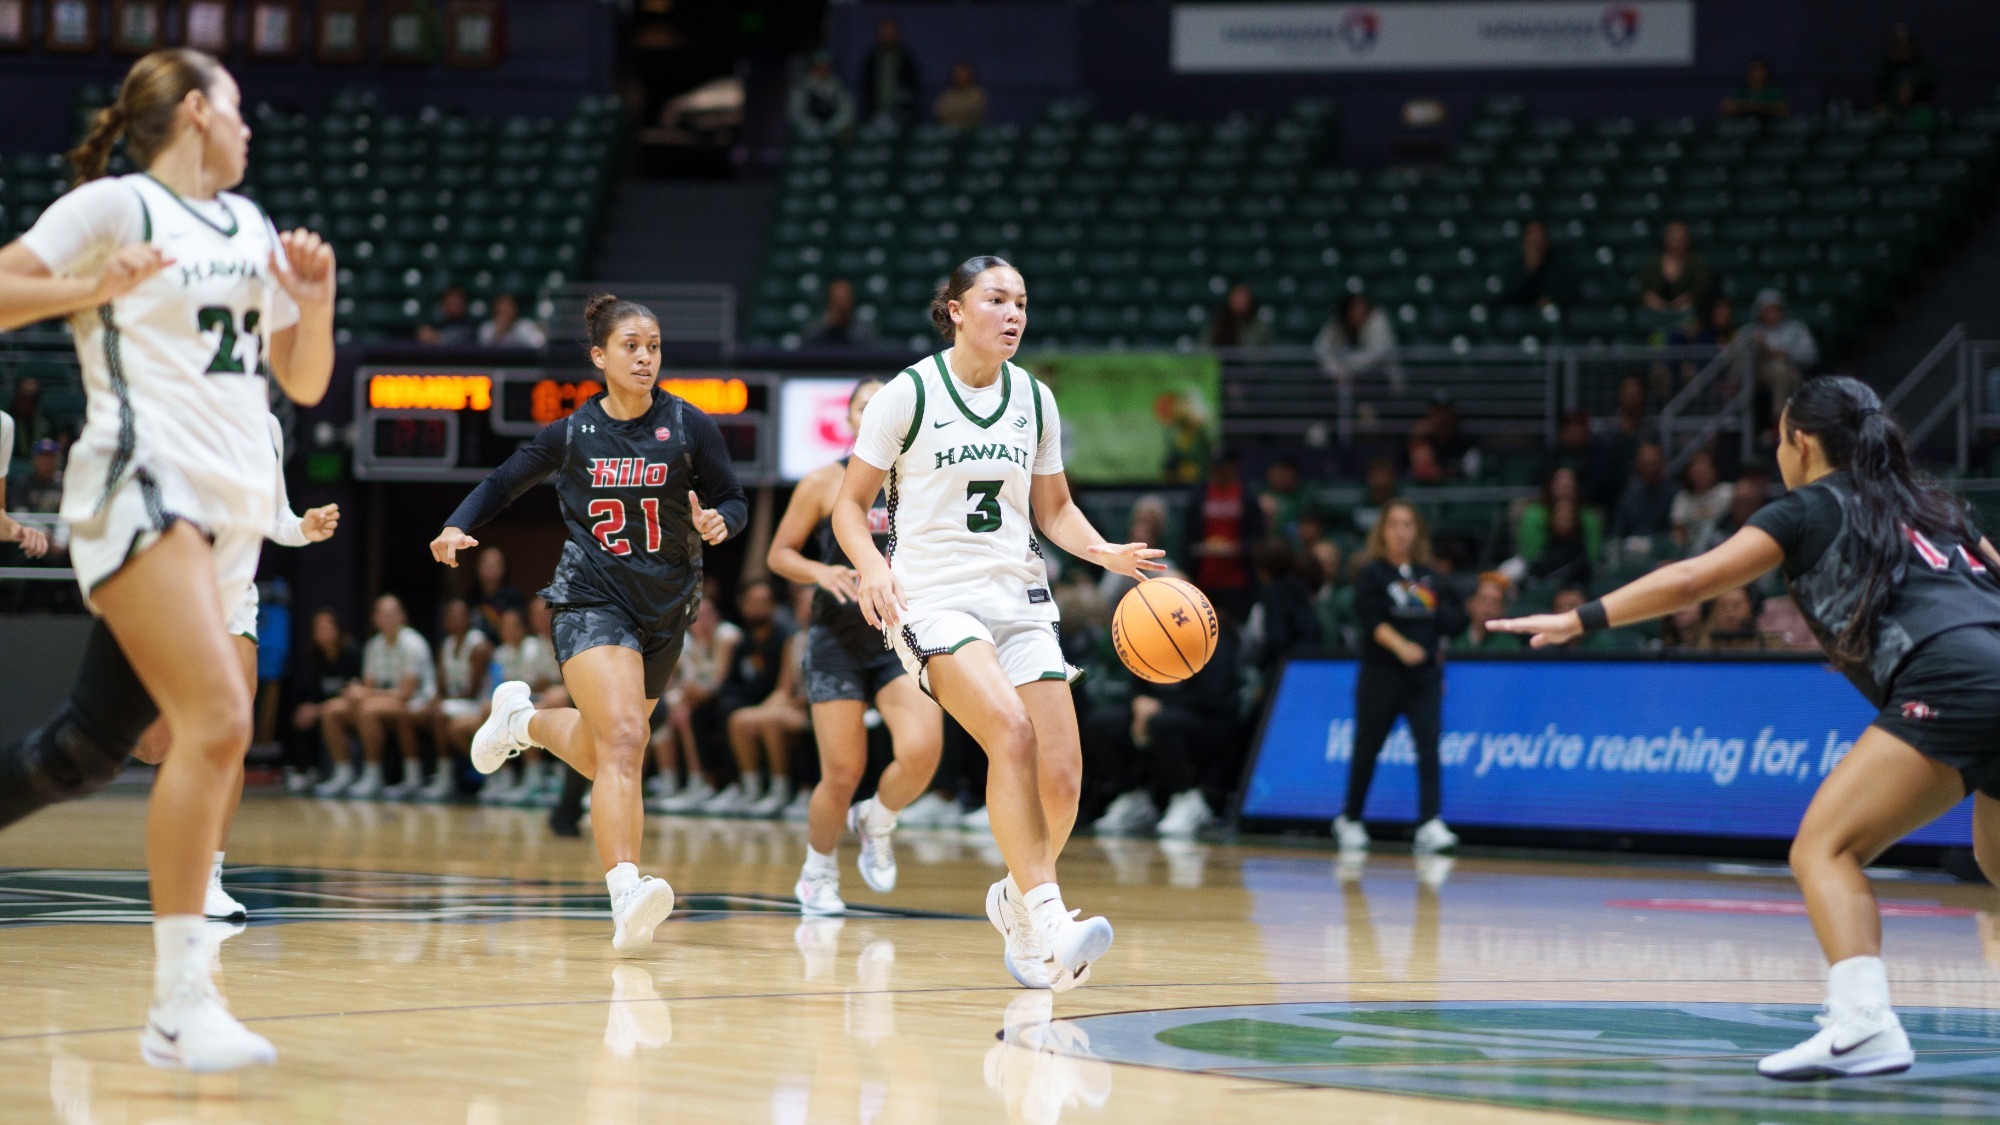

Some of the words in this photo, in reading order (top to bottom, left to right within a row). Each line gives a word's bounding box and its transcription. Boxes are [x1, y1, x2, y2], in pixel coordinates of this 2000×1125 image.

[586, 457, 668, 488] Hilo
[588, 498, 662, 556] 21
[966, 479, 1005, 534] 3
[1474, 722, 1586, 777] you're
[1585, 725, 1747, 787] reaching
